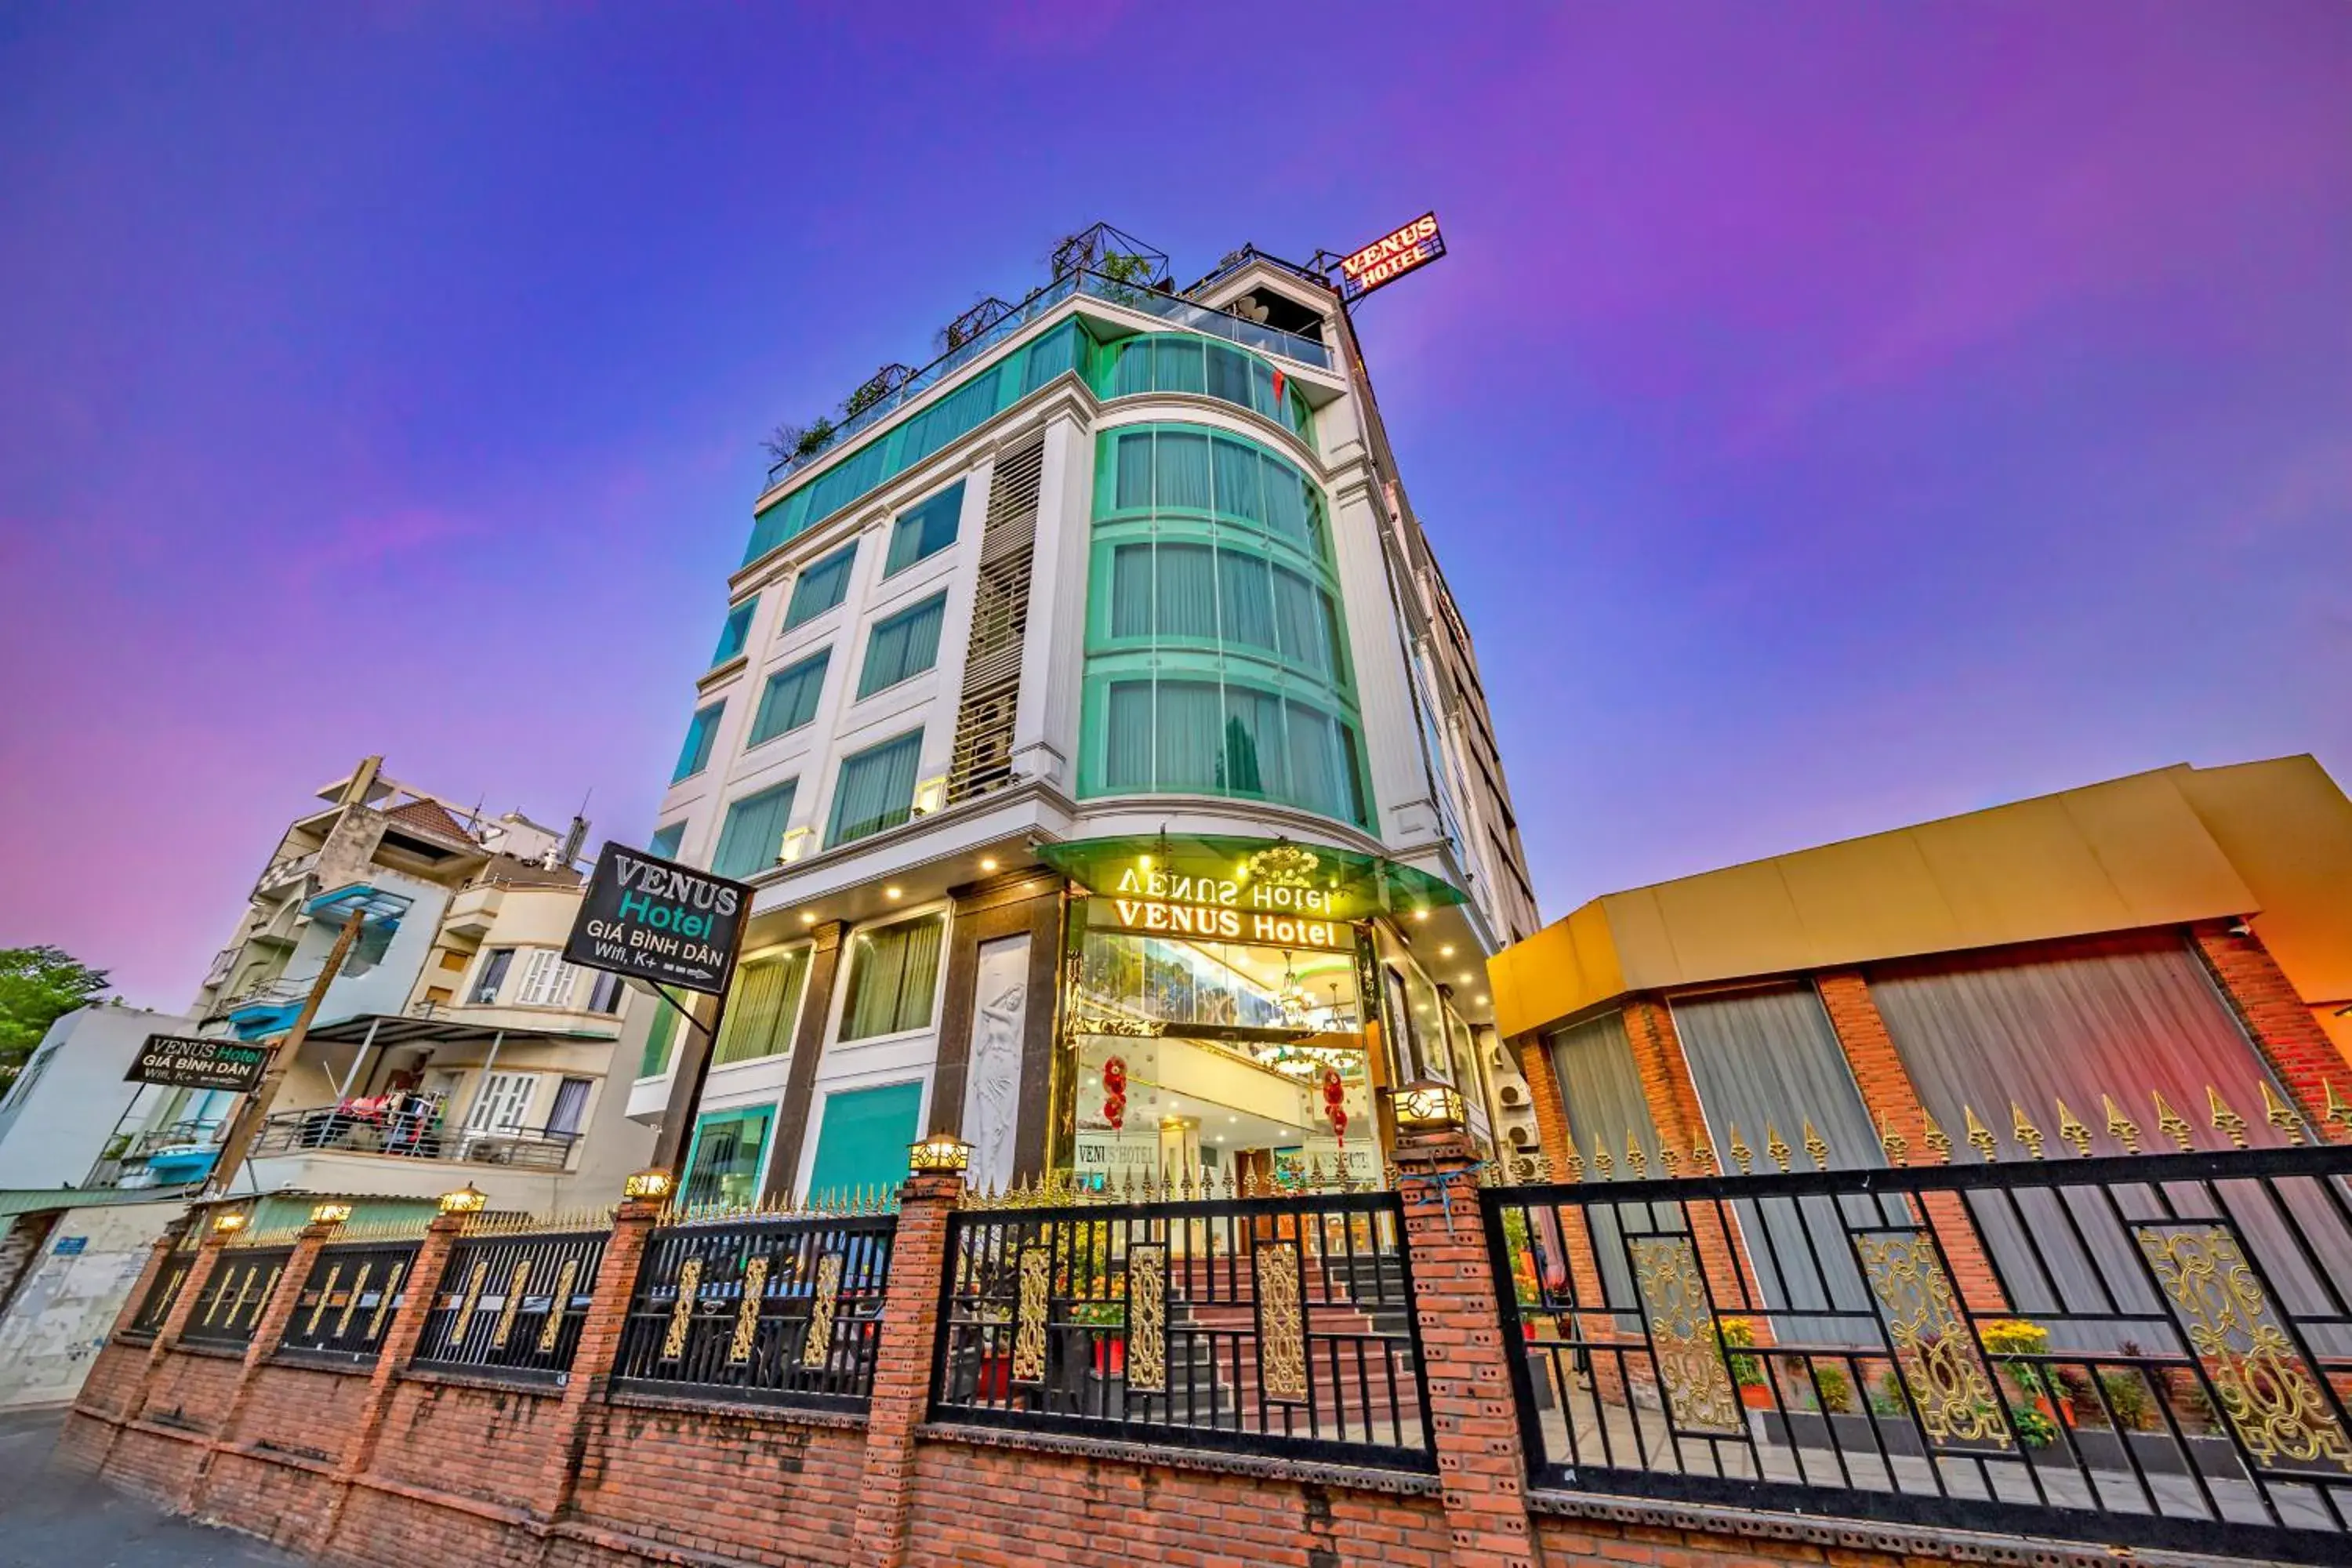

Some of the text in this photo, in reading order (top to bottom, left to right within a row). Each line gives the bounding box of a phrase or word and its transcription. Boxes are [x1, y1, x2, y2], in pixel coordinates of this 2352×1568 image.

[1341, 215, 1437, 276] VENUS
[1361, 245, 1427, 288] HOTEL
[615, 855, 739, 916] VENUS
[618, 890, 714, 940] Hotel
[1115, 899, 1334, 946] VENUS Hotel
[586, 919, 724, 967] GIÁ BÌNH DÂN
[594, 941, 659, 969] Wifi, K+
[143, 1054, 252, 1076] GIÁ BÌNH DÂN
[153, 1038, 263, 1062] VENUS Hotel
